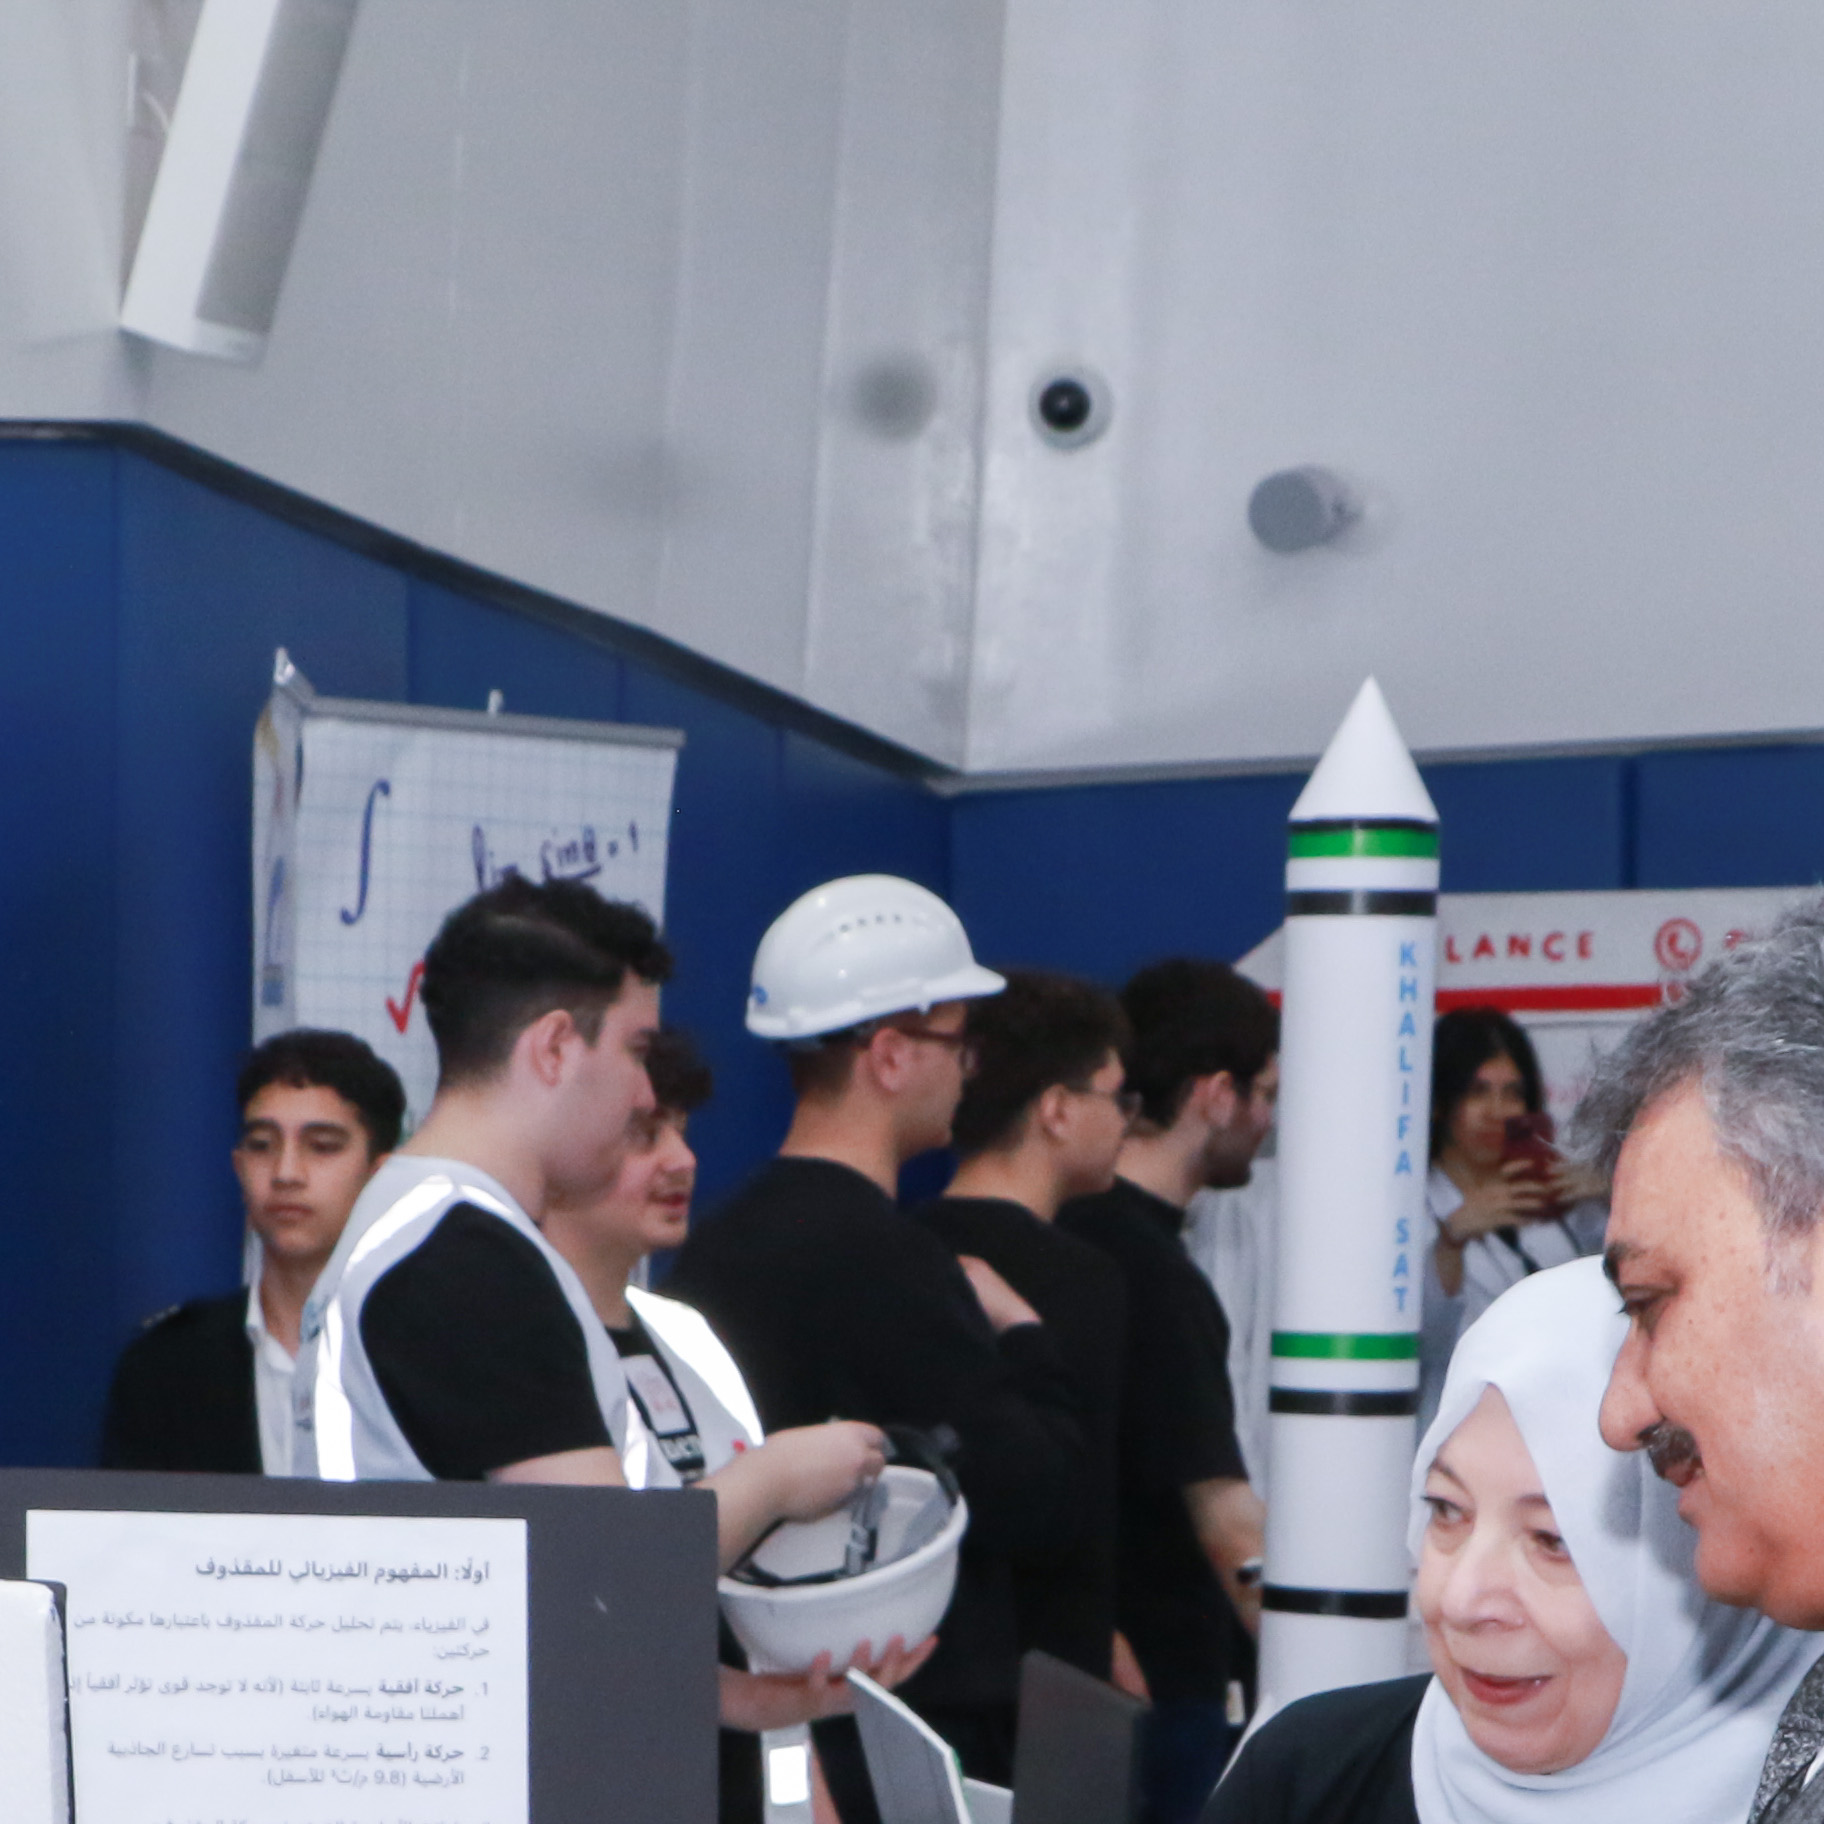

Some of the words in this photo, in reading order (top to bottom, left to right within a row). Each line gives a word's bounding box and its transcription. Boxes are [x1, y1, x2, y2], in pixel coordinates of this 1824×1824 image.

[1394, 938, 1419, 1177] KHALIFA
[1392, 1217, 1411, 1313] SAT
[195, 1556, 283, 1582] للمقذوف
[373, 1561, 449, 1587] المفهوم
[73, 1616, 97, 1630] من
[102, 1611, 145, 1630] مكونة
[149, 1612, 211, 1631] باعتبارها
[216, 1613, 283, 1633] المقذوف
[289, 1614, 326, 1633] حركة
[330, 1615, 375, 1634] تحليل
[379, 1619, 405, 1636] يتم
[471, 1617, 490, 1637] في
[195, 1679, 232, 1697] توجد
[326, 1679, 372, 1699] بسرعة
[378, 1677, 420, 1699] أفقية
[424, 1679, 465, 1700] حركة
[364, 1705, 415, 1724] مقاومة
[171, 1741, 216, 1763] تسارع
[323, 1744, 370, 1763] بسرعة
[375, 1740, 419, 1763] رأسية
[424, 1743, 465, 1764] حركة
